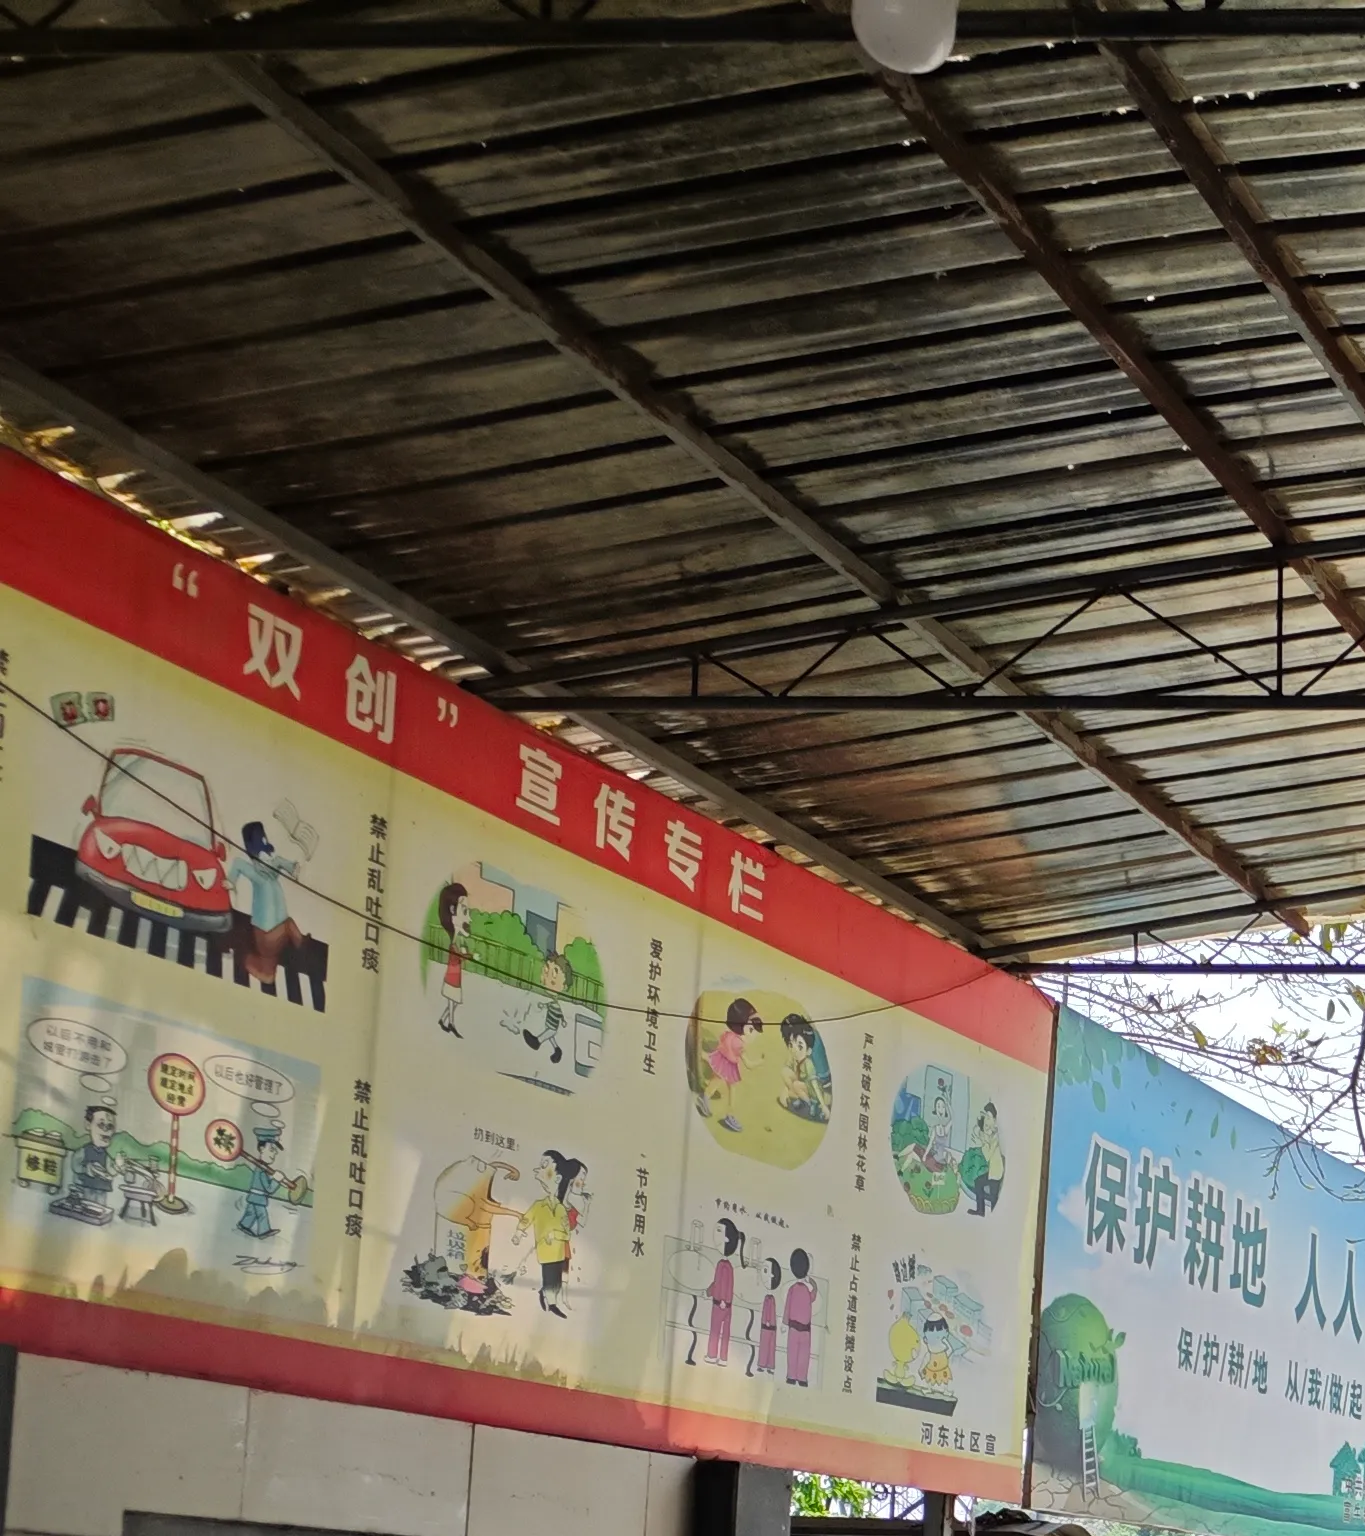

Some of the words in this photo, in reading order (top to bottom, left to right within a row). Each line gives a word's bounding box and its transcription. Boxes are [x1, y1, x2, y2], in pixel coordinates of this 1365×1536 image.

[361, 813, 389, 975] 禁止乱吐口痰
[515, 743, 766, 922] 宣传专栏
[642, 938, 663, 1076] 爱护环境卫生
[344, 1078, 372, 1239] 禁止乱吐口痰
[853, 1032, 875, 1193] 严禁破坏园林花草
[631, 1166, 650, 1258] 节约用水
[1084, 1140, 1269, 1309] 保护耕地
[841, 1232, 862, 1395] 禁止占道摆摊设点
[920, 1421, 997, 1456] 河东社区宣
